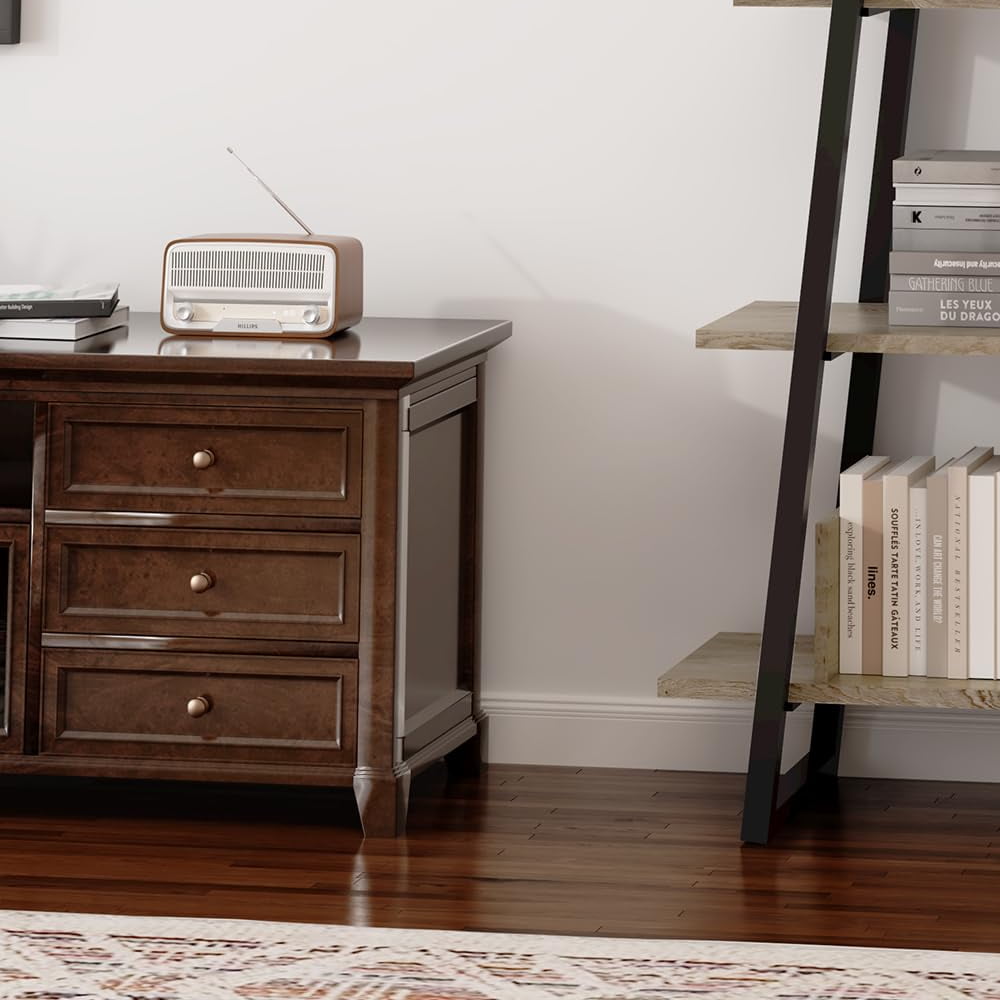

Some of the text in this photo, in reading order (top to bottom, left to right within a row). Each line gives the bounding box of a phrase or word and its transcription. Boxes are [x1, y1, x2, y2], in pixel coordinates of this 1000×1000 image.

[912, 211, 922, 223] K
[934, 259, 966, 268] Insecurity
[908, 276, 993, 292] GATHERING BLUE
[940, 300, 992, 310] LES YEUX
[940, 312, 956, 321] DU
[891, 508, 900, 550] SOUFFLÉS
[891, 552, 899, 579] TARTE
[845, 522, 856, 639] exploring black sand beaches
[867, 565, 879, 600] lines.
[932, 534, 944, 624] CAN ART CHANGE THE WORLD?
[891, 581, 899, 607] TATIN
[914, 601, 922, 622] AND
[914, 627, 922, 652] LIFE
